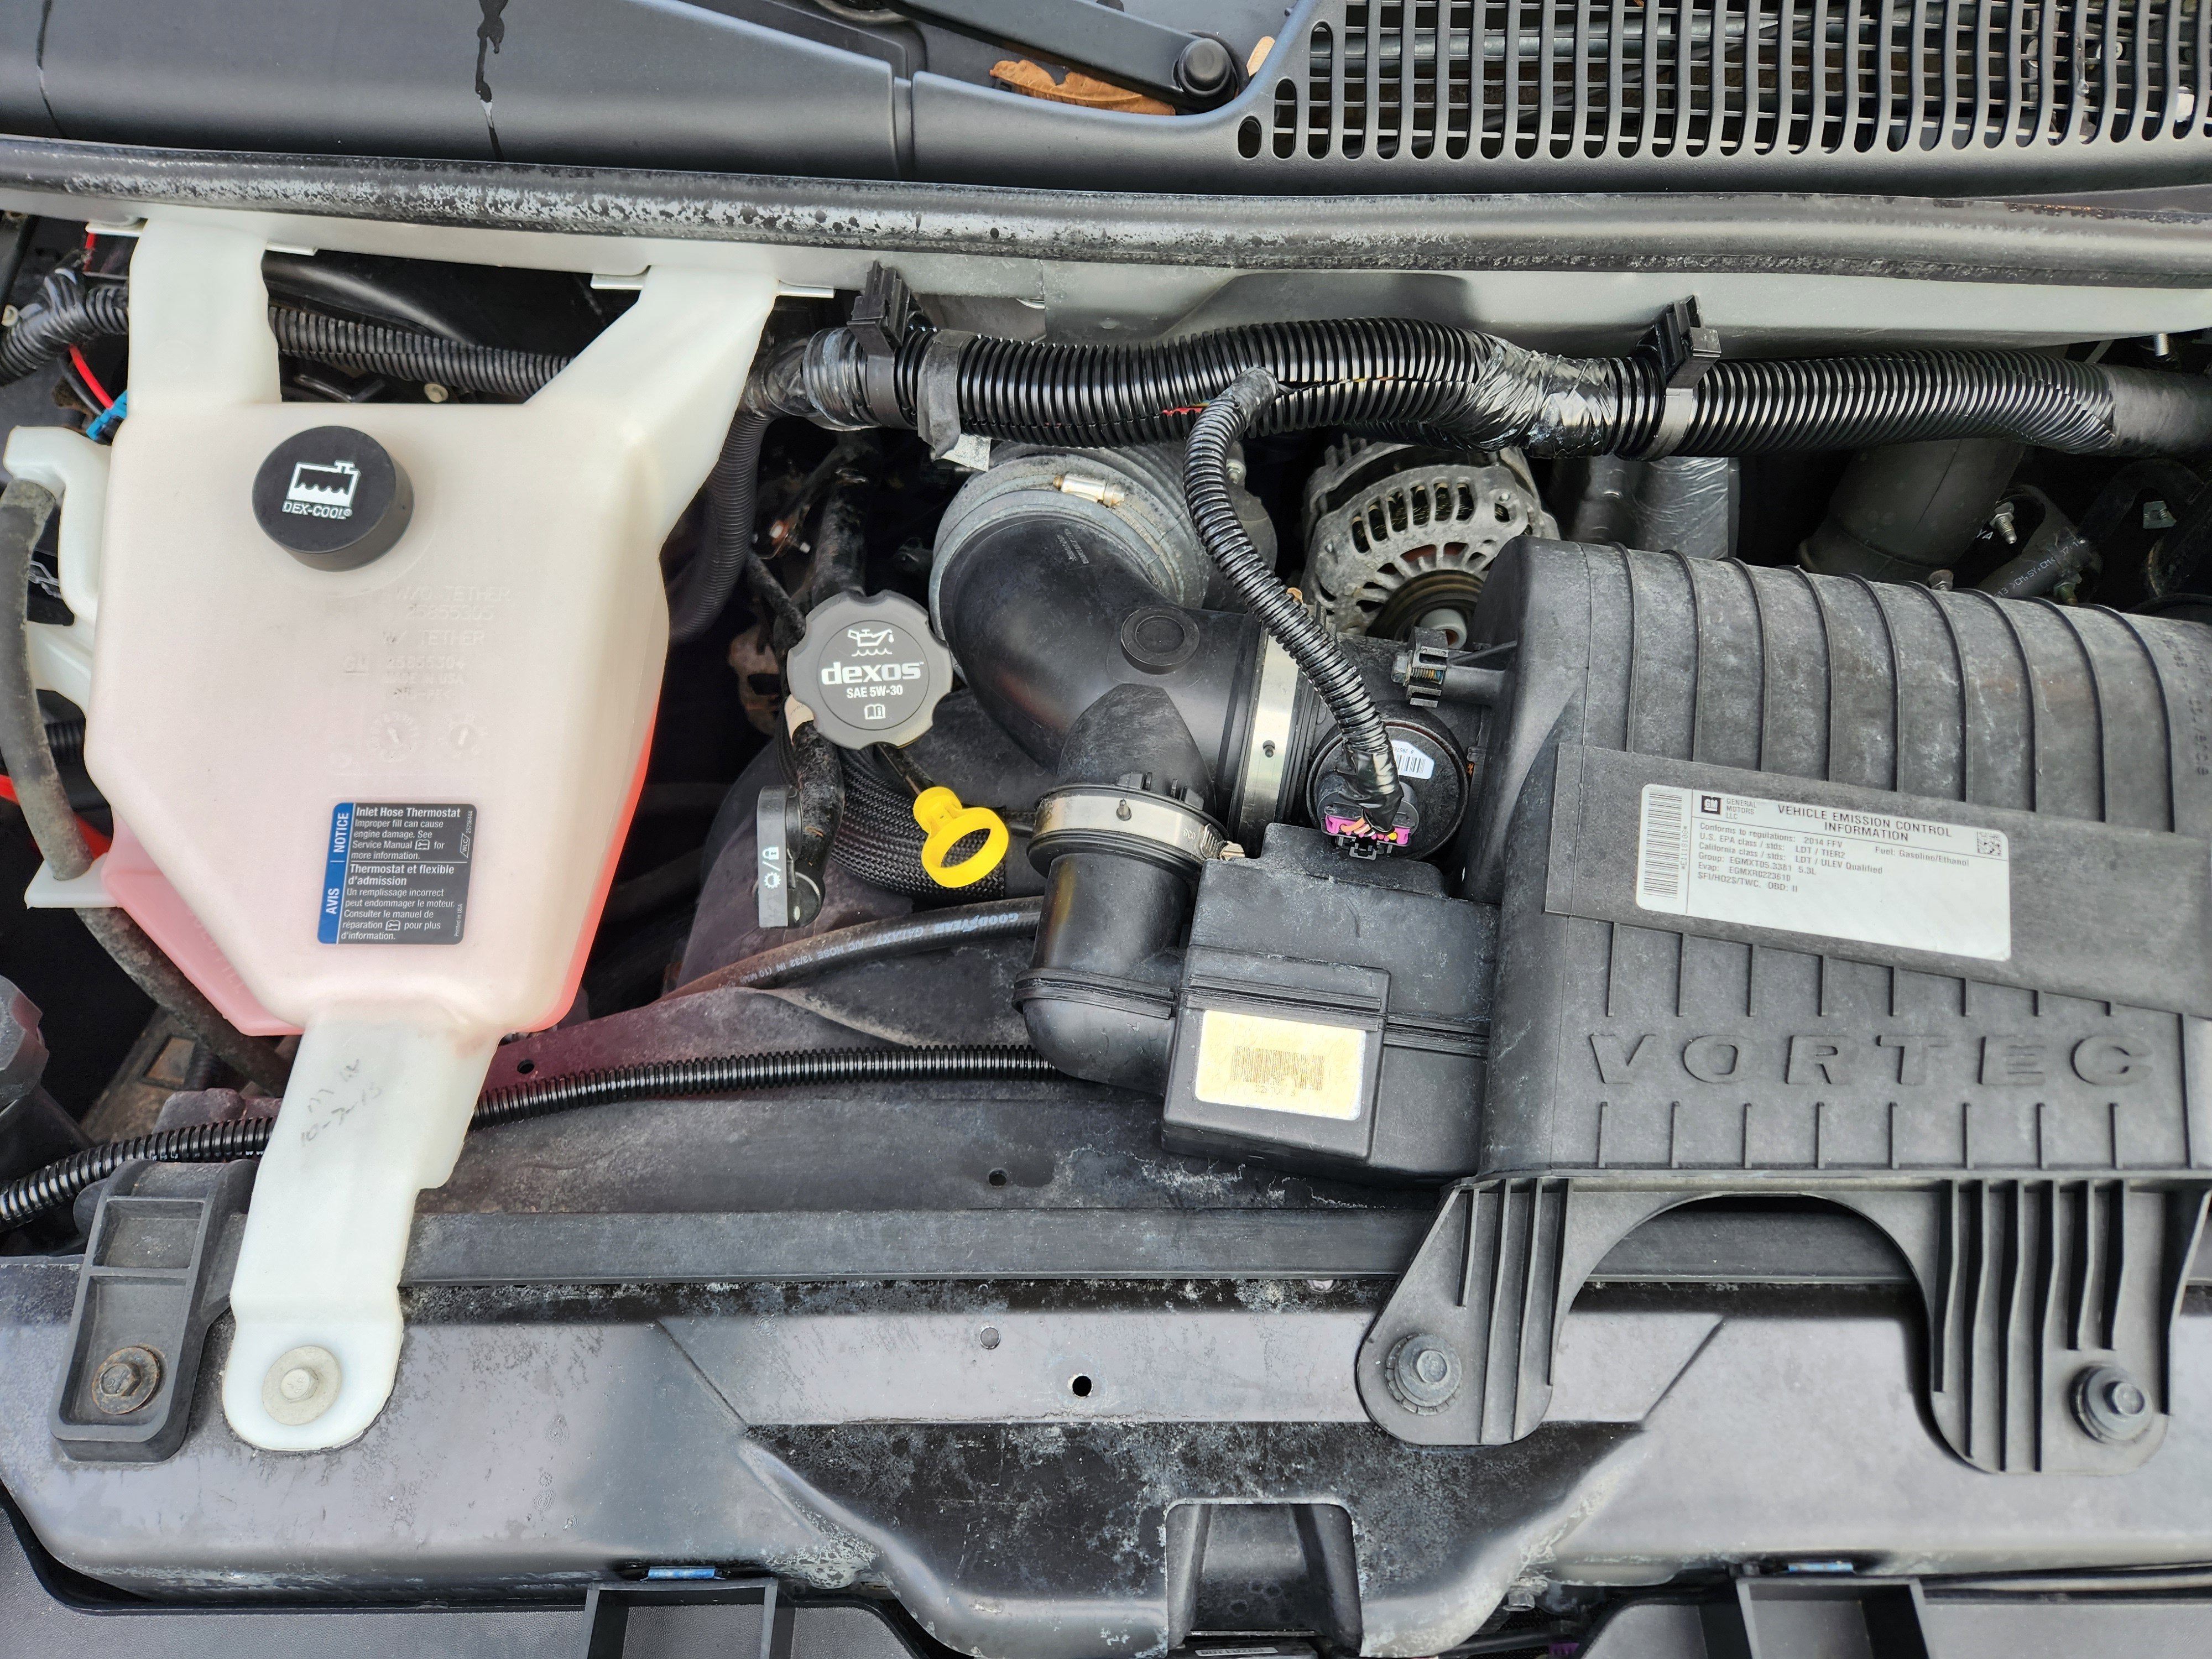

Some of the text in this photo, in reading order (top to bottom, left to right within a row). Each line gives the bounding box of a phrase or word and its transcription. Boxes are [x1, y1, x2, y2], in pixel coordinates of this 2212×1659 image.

[847, 685, 902, 698] SAE 5W-30
[1726, 798, 1756, 808] GENERAL
[356, 807, 461, 817] Inlet Hose Thermostat
[1726, 805, 1754, 815] MOTORS
[354, 820, 390, 828] Improper
[392, 820, 401, 828] fill
[1778, 805, 1952, 837] VEHICLE EMISSION CONTROL
[333, 812, 349, 853] NOTICE
[353, 831, 379, 839] engine
[382, 831, 415, 839] damage.
[1700, 822, 1736, 834] Conforms
[1750, 830, 1796, 842] regulations:
[1804, 837, 1823, 845] 2014
[1827, 839, 1843, 848] FFV
[1825, 822, 1908, 842] INFORMATION
[352, 841, 445, 849] Service Manual for
[1699, 832, 1715, 841] U.S.
[1720, 836, 1735, 844] EPA
[1738, 838, 1757, 847] class
[1796, 846, 1812, 854] LDT
[1822, 849, 1846, 859] TIER2
[373, 851, 420, 860] information.
[1699, 842, 1736, 854] California
[1739, 848, 1758, 857] class
[1767, 852, 1786, 861] stds:
[1796, 855, 1811, 864] LDT
[1822, 859, 1843, 868] ULEV
[1846, 862, 1882, 874] Qualified
[1875, 847, 1969, 867] Fuel: Gasoline/Ethanol
[1698, 862, 1719, 872] Evap:
[1699, 852, 1724, 863] Group:
[1798, 866, 1816, 875] 5.3L
[350, 864, 454, 874] Thermostat et flexible
[348, 877, 406, 885] d'admission
[1768, 882, 1788, 891] OBD:
[359, 888, 406, 898] remplissage
[326, 888, 339, 915] AVIS
[345, 900, 362, 909] peut
[364, 899, 415, 909] endommager
[418, 899, 424, 907] le
[344, 910, 434, 918] Consulter le manuel de
[342, 921, 441, 930] réparation pour plus
[933, 912, 1019, 934] GOODYEAR
[341, 931, 395, 940] d'information.
[875, 926, 924, 946] GALAXY
[817, 945, 845, 959] HOSE
[776, 962, 786, 972] IN
[1588, 1034, 2154, 1087] VORTEC
